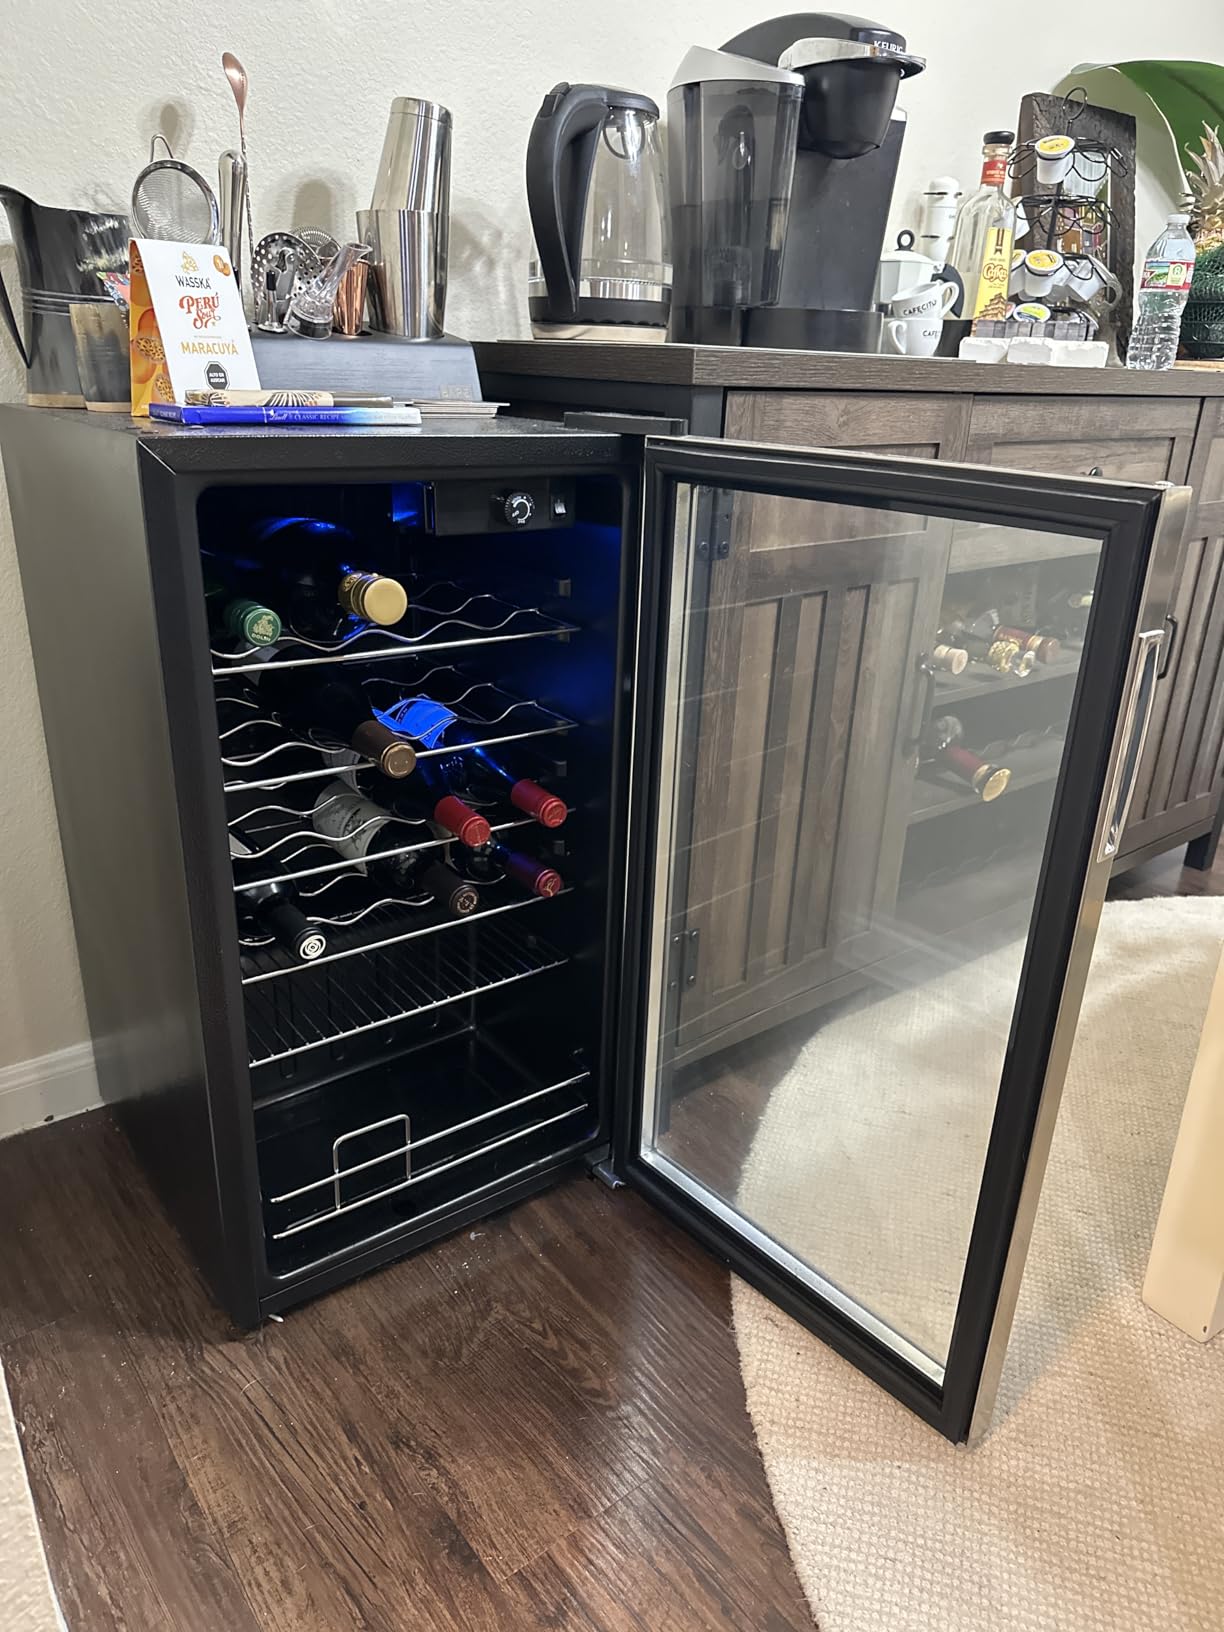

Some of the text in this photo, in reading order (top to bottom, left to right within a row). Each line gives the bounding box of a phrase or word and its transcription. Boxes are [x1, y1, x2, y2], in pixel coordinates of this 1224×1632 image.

[175, 275, 212, 290] WASSKA
[179, 292, 220, 314] PERÚ
[180, 340, 239, 355] MARACUYÁ
